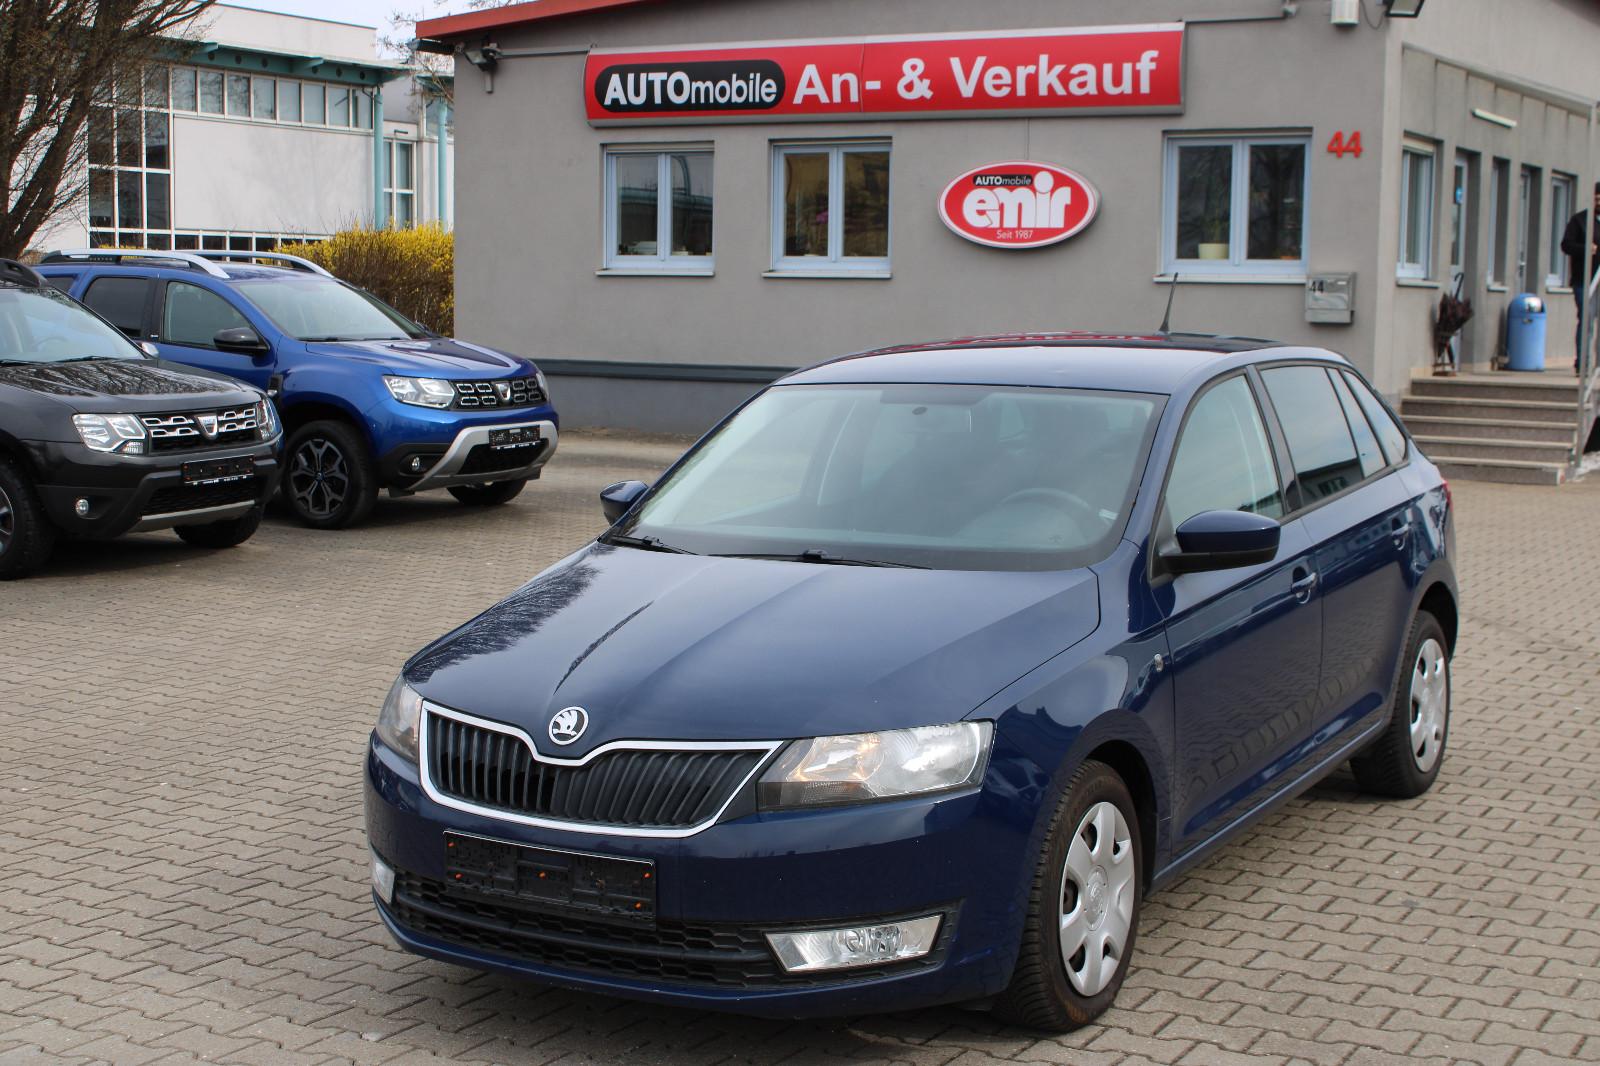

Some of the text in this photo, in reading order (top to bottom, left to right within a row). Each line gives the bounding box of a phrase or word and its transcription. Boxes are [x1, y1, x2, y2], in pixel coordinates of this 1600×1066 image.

[603, 50, 1159, 105] AUTOmobile An- & Verkauf
[1327, 131, 1363, 158] 44
[975, 175, 1032, 185] AUTOmobile
[962, 171, 1072, 228] emir
[996, 230, 1034, 239] Seit 1987
[1309, 280, 1325, 294] 44
